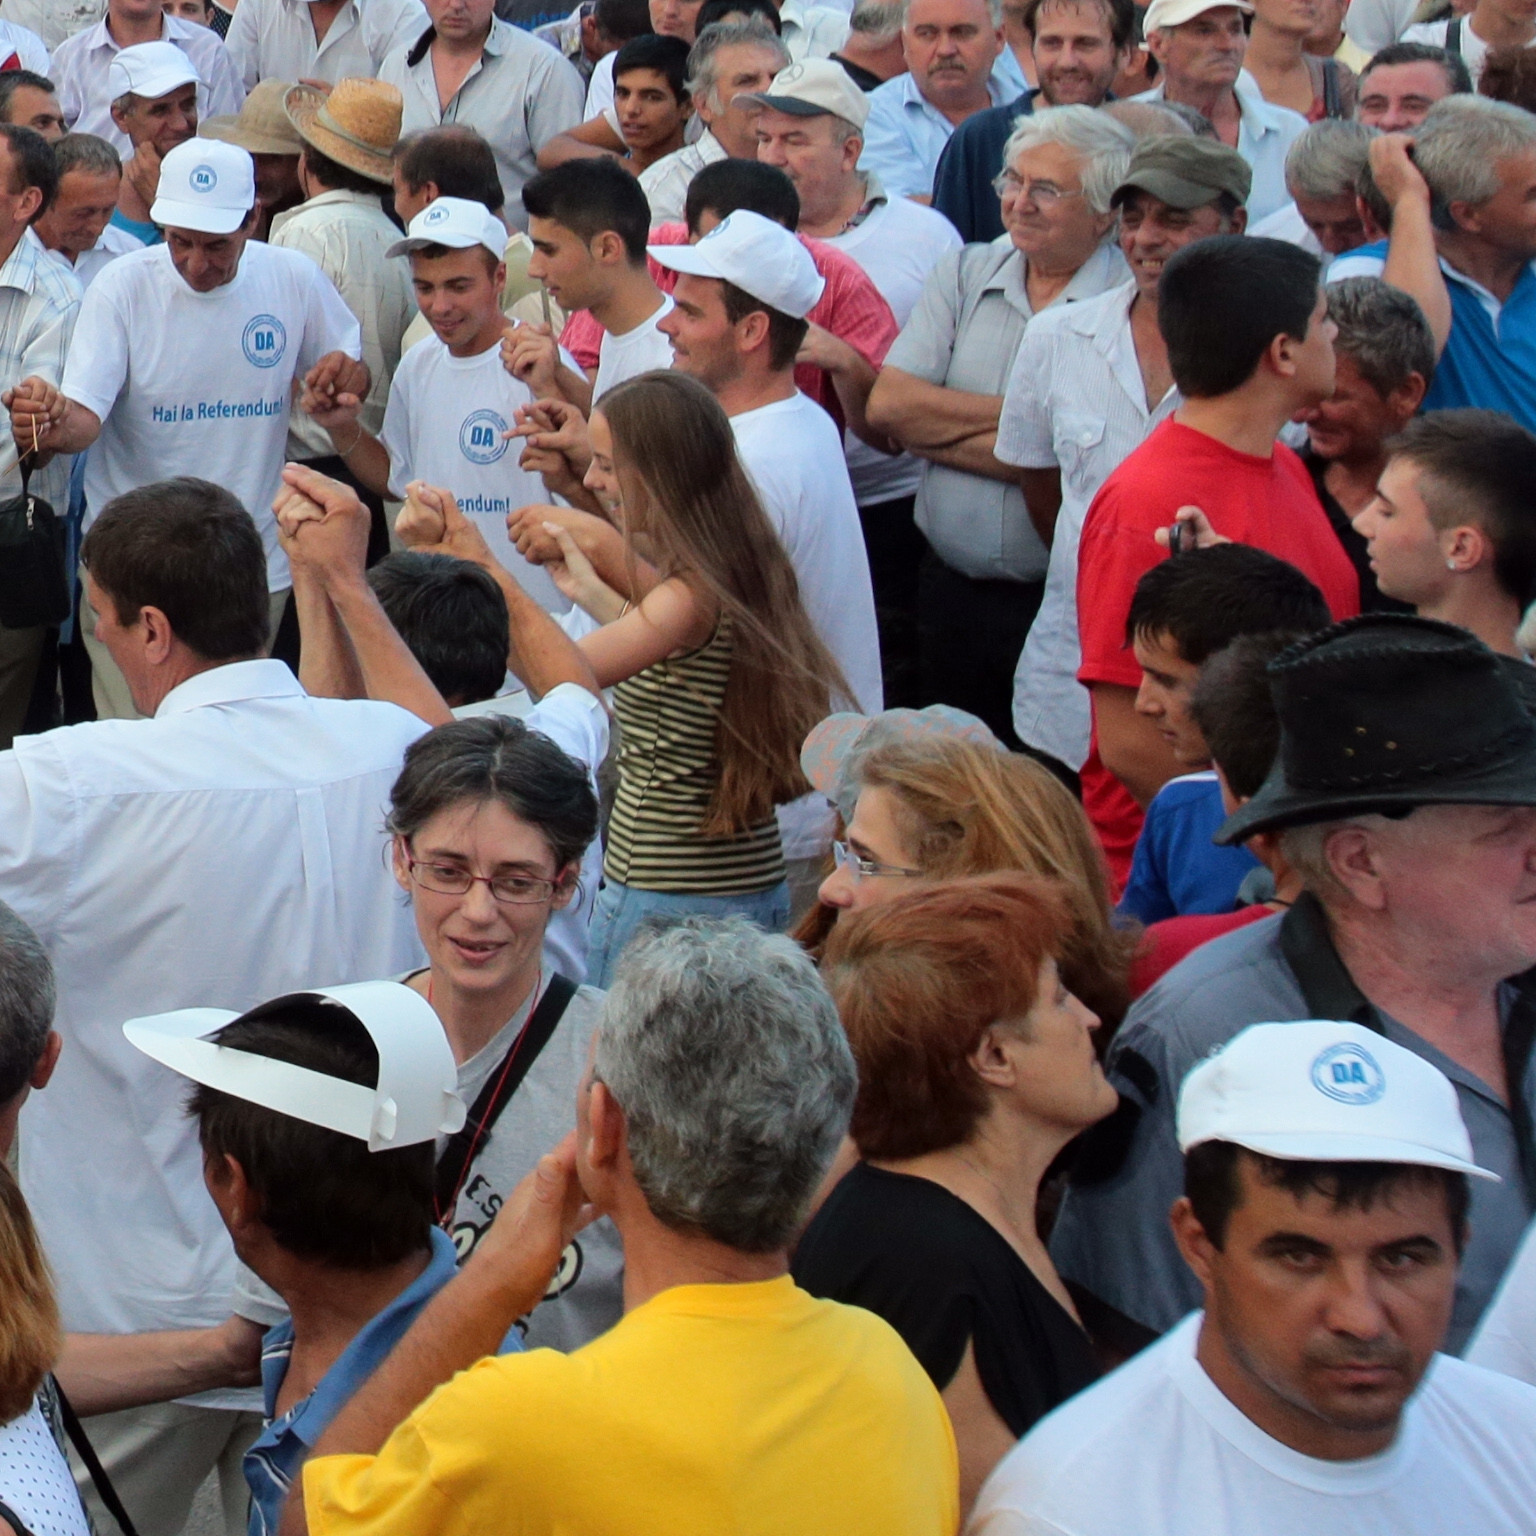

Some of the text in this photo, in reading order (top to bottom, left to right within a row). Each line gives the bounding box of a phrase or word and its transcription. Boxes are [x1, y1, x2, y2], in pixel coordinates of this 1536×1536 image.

[196, 173, 210, 185] DA
[255, 331, 275, 351] DA
[152, 397, 284, 423] Hai la Referendum!
[471, 426, 494, 448] DA
[1331, 1061, 1368, 1084] DA
